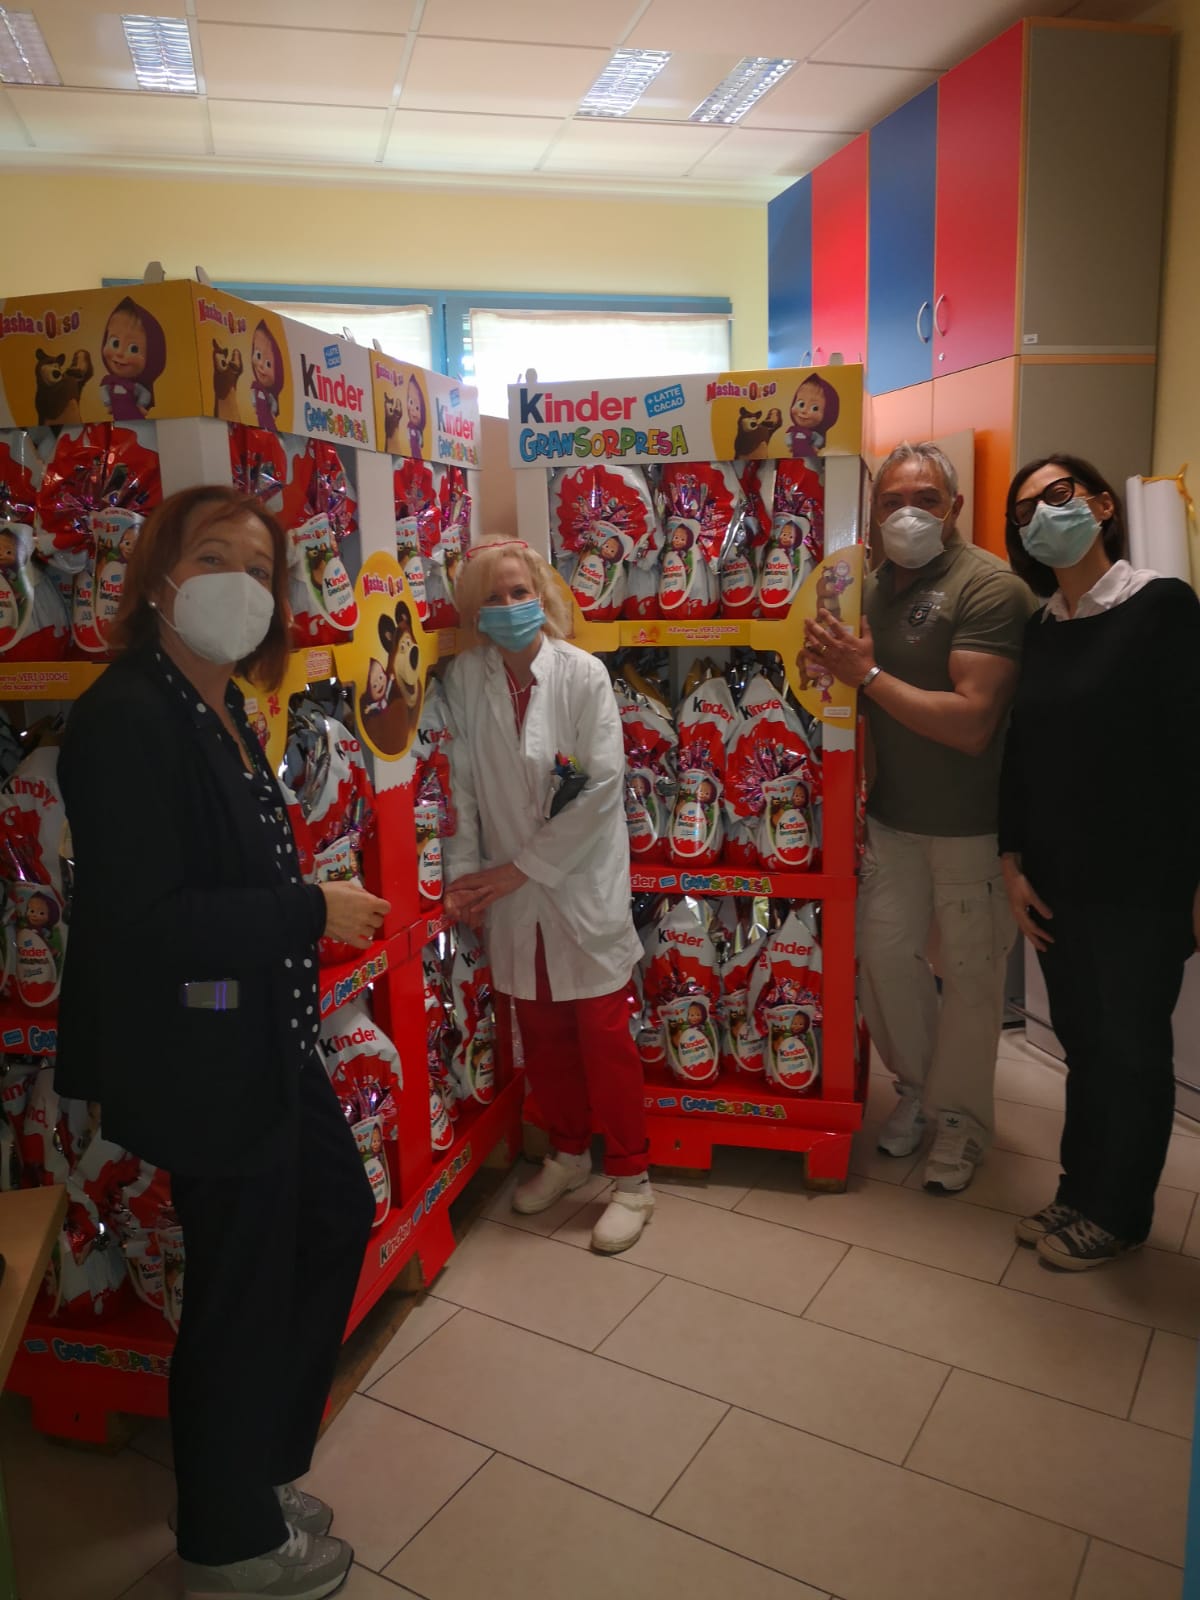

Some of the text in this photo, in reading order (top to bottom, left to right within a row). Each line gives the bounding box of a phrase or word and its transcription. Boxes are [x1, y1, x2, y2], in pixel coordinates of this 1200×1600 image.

[0, 311, 36, 340] asha
[300, 353, 364, 412] Kinder
[706, 382, 741, 401] Masha
[748, 382, 776, 400] Orso
[436, 397, 475, 441] Kinder
[519, 388, 637, 424] Kinder
[519, 424, 689, 462] GRANSORPRESA
[362, 574, 384, 597] Masha
[693, 696, 735, 724] Kinder
[739, 698, 782, 721] Kinde
[319, 1027, 377, 1058] Kinder
